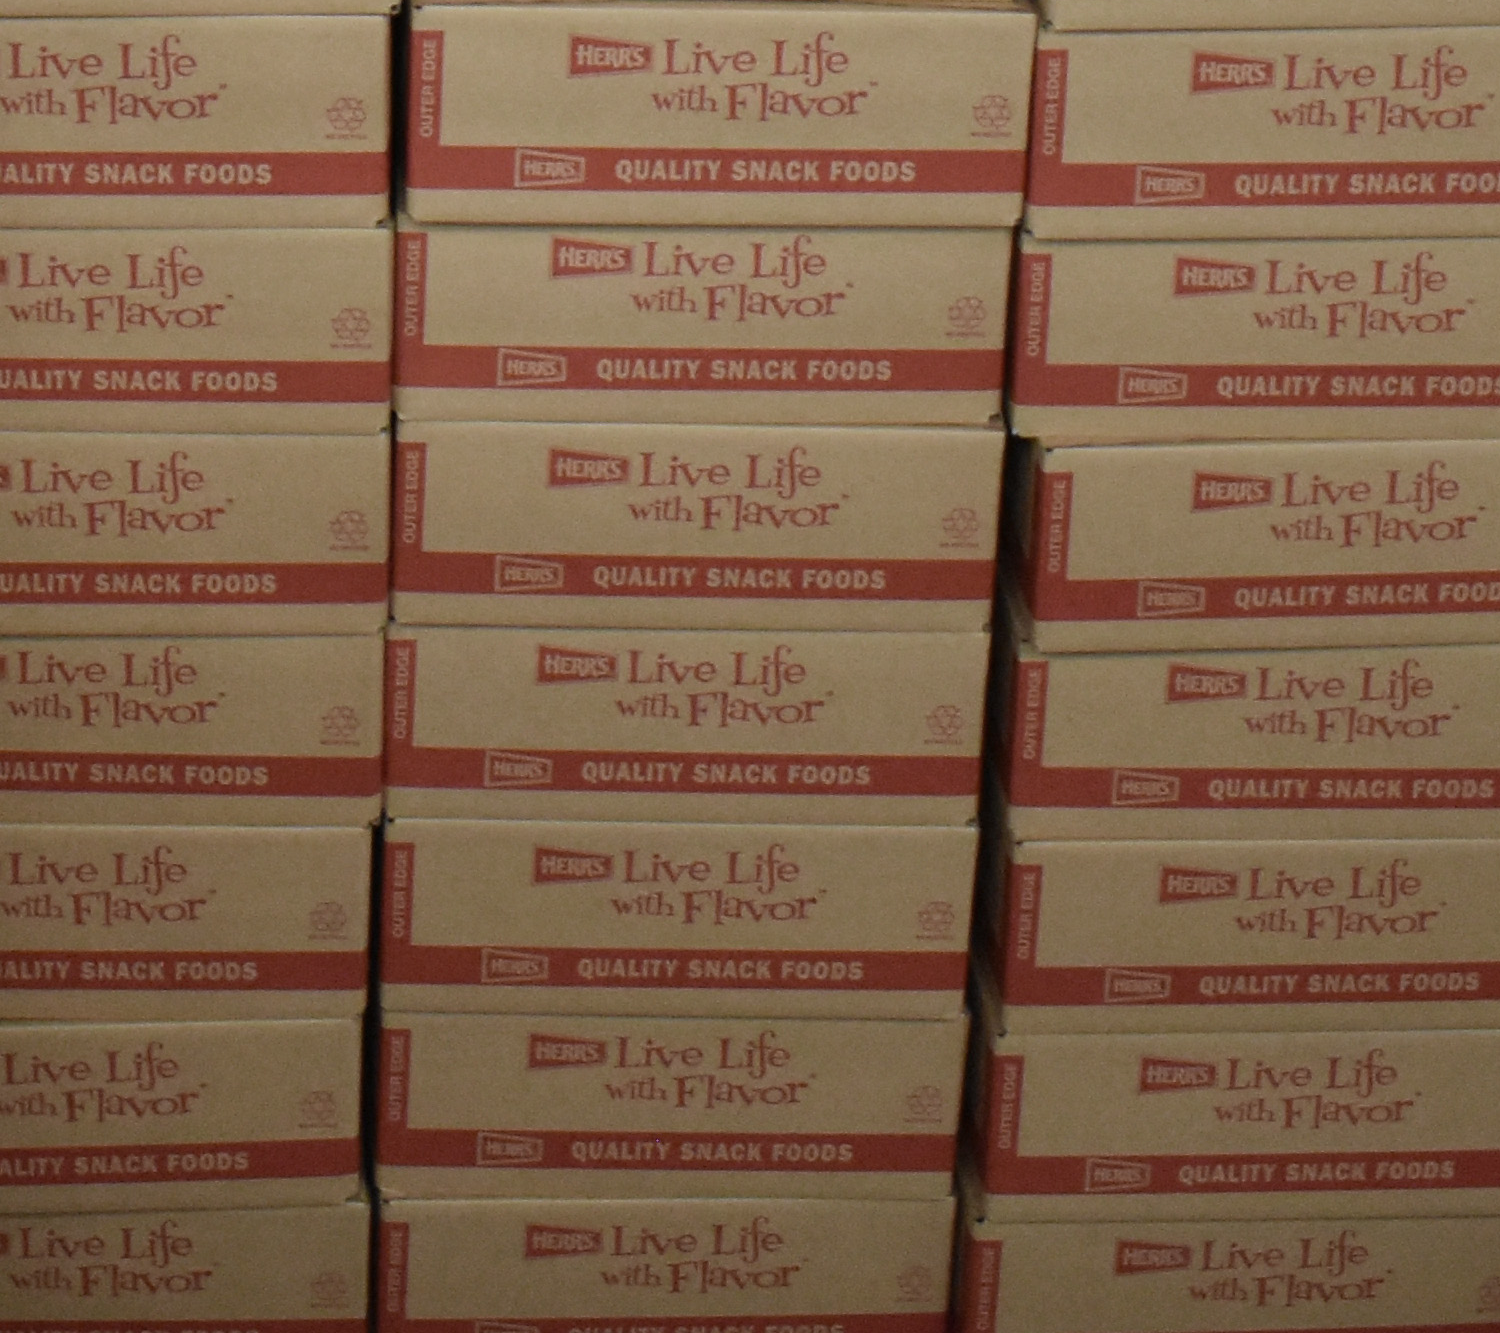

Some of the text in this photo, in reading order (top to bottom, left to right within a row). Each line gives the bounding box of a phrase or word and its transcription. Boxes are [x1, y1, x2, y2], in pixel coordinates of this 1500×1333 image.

[613, 1037, 702, 1069] Live
[717, 1031, 791, 1079] Life
[604, 1075, 809, 1110] with Flavor
[572, 1140, 669, 1162] QUALITY
[680, 1142, 761, 1162] SNACK
[771, 1141, 853, 1162] FOODS
